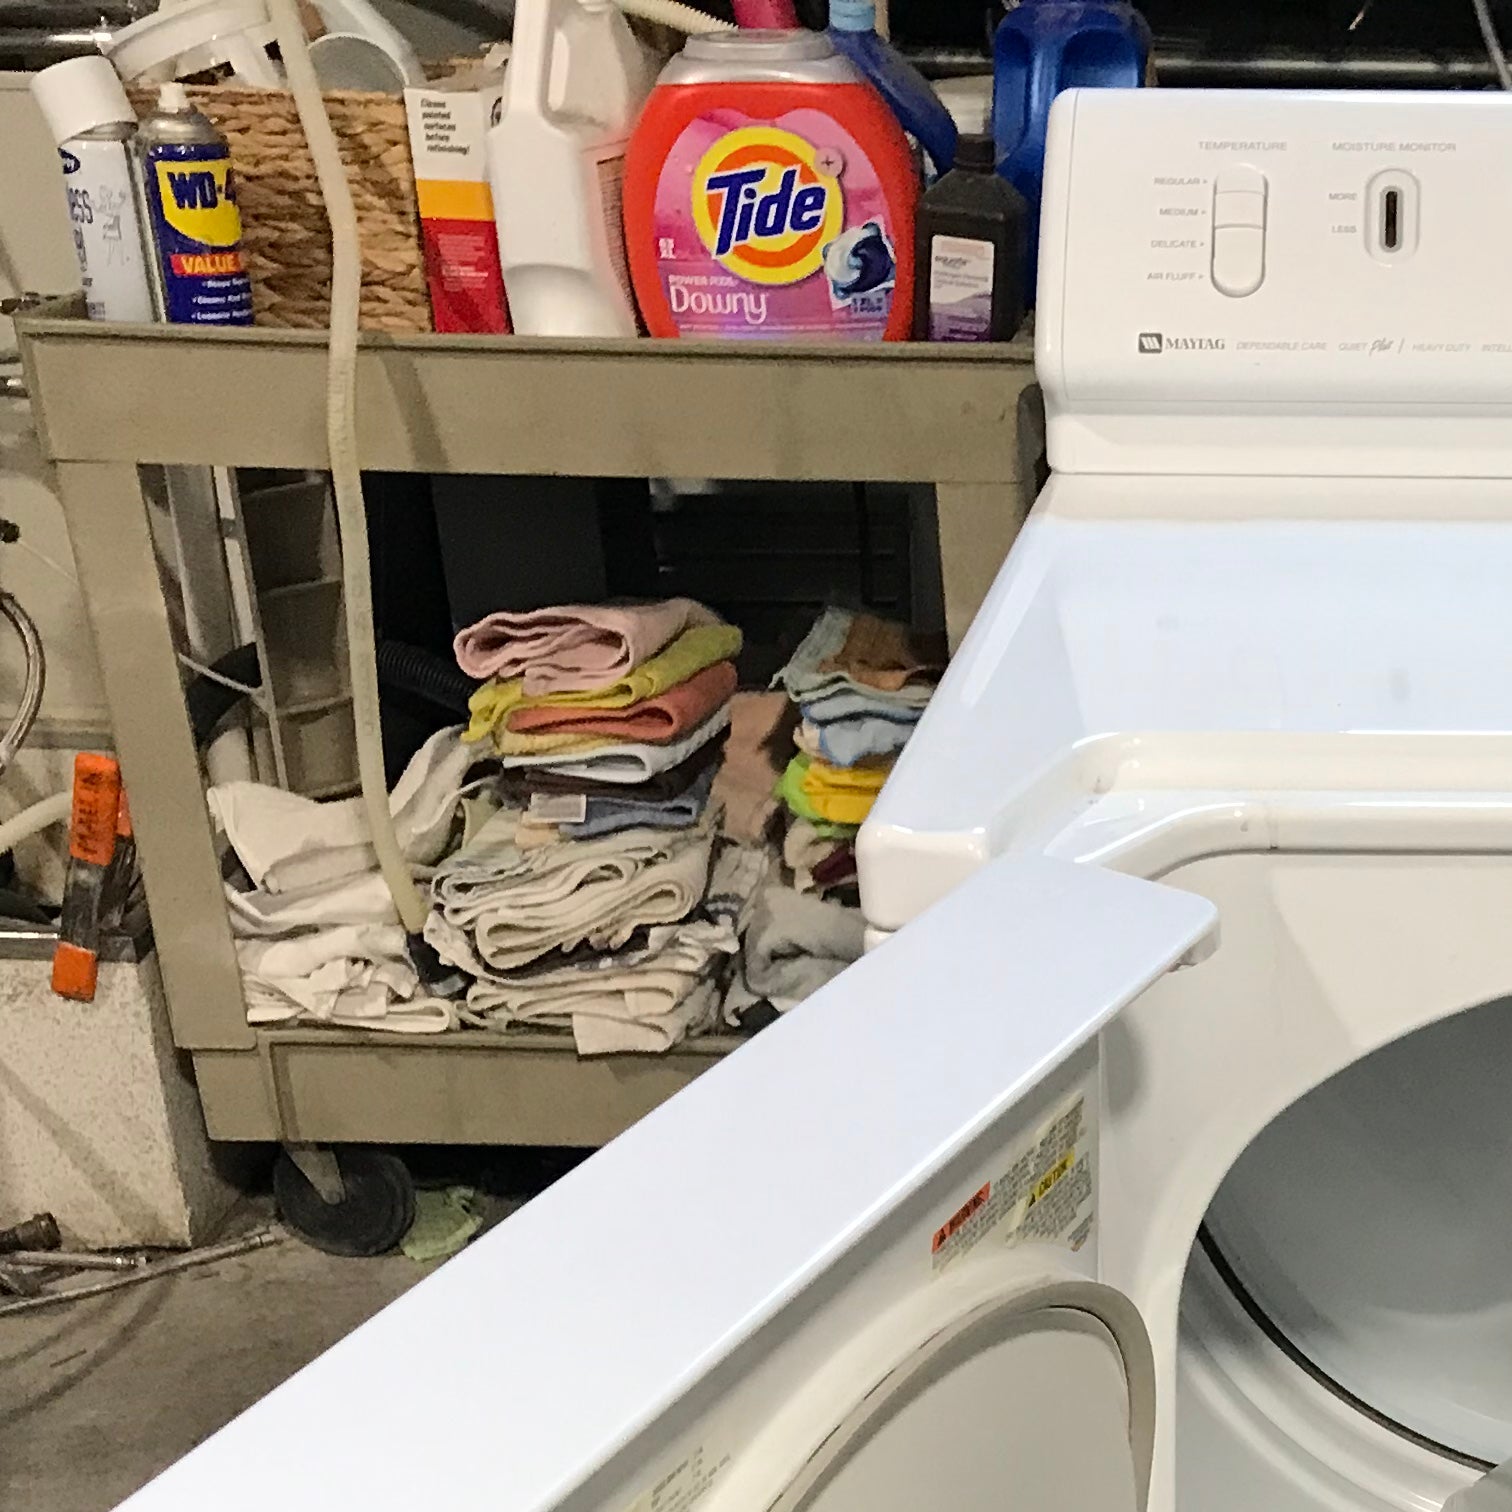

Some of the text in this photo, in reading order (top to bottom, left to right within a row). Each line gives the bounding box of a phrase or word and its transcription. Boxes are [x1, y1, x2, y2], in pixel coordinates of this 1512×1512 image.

[1198, 141, 1288, 152] TEMPERATURE
[1332, 142, 1456, 152] MOISTURE MONITOR
[707, 168, 826, 255] Tide
[180, 253, 236, 274] VALUE
[670, 285, 768, 324] Downy
[1165, 338, 1226, 351] MAYTAG
